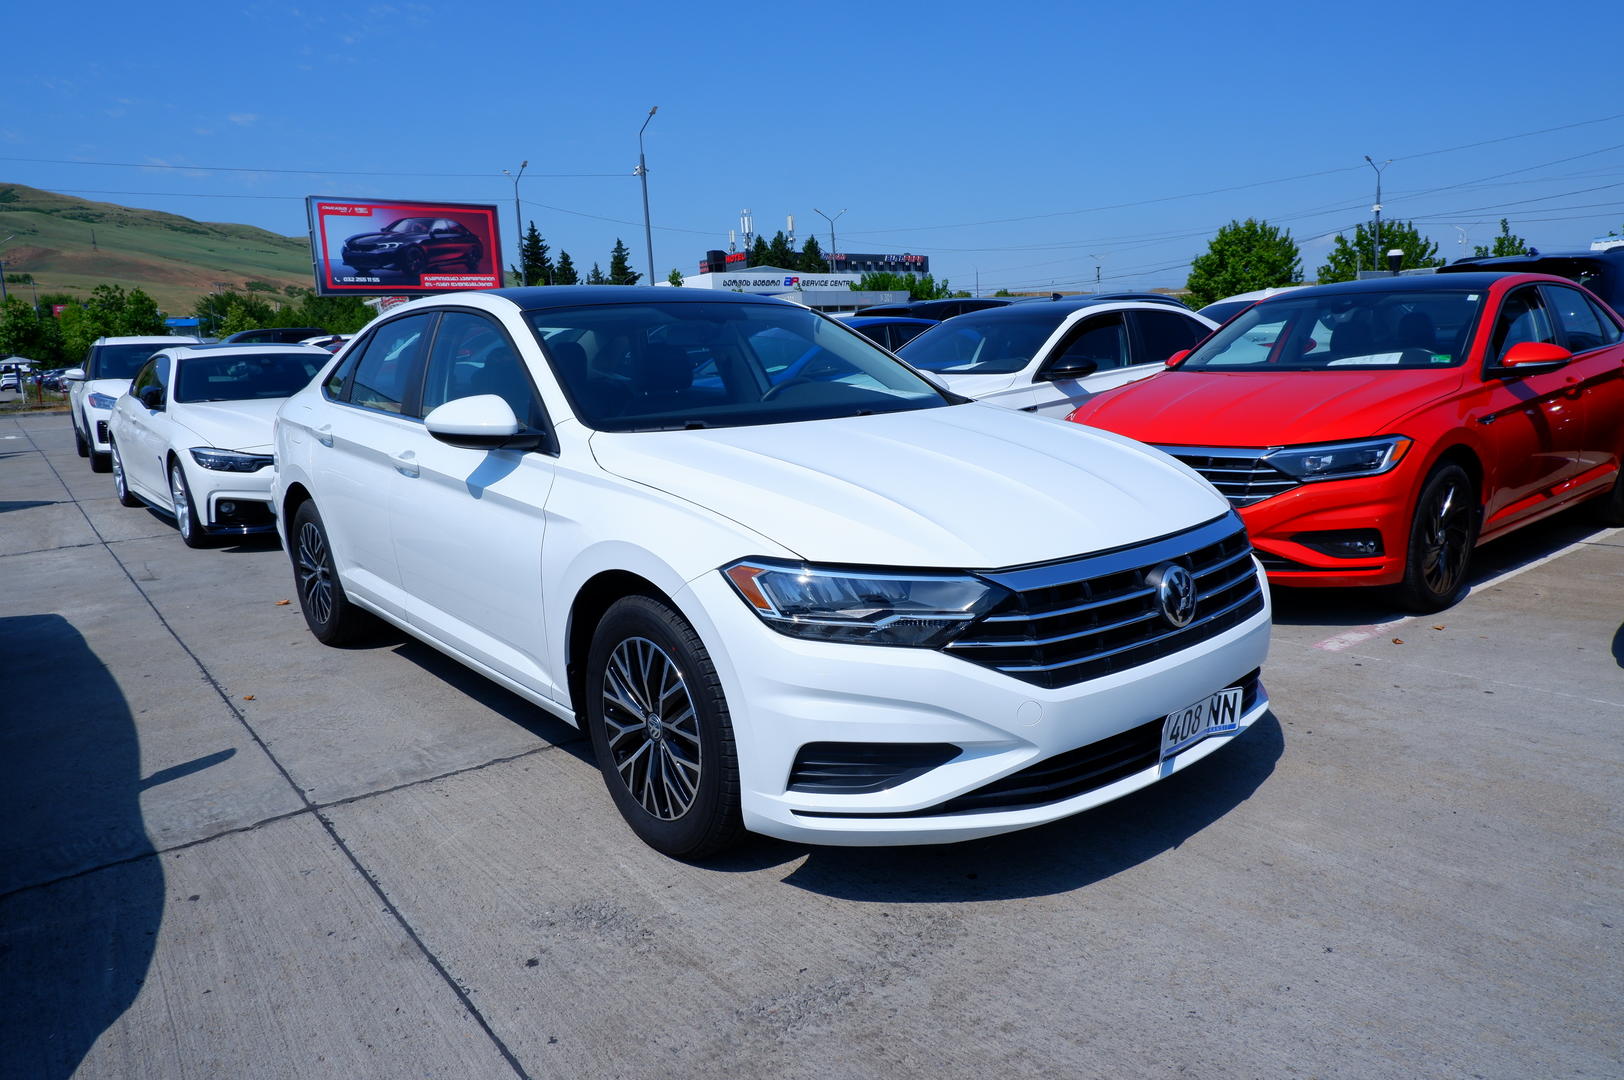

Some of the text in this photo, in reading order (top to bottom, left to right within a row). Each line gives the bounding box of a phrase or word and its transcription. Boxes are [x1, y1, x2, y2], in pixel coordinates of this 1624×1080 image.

[725, 252, 747, 264] HOTEL
[801, 279, 852, 287] SERVICE CENTR
[1169, 692, 1238, 744] 408 NN
